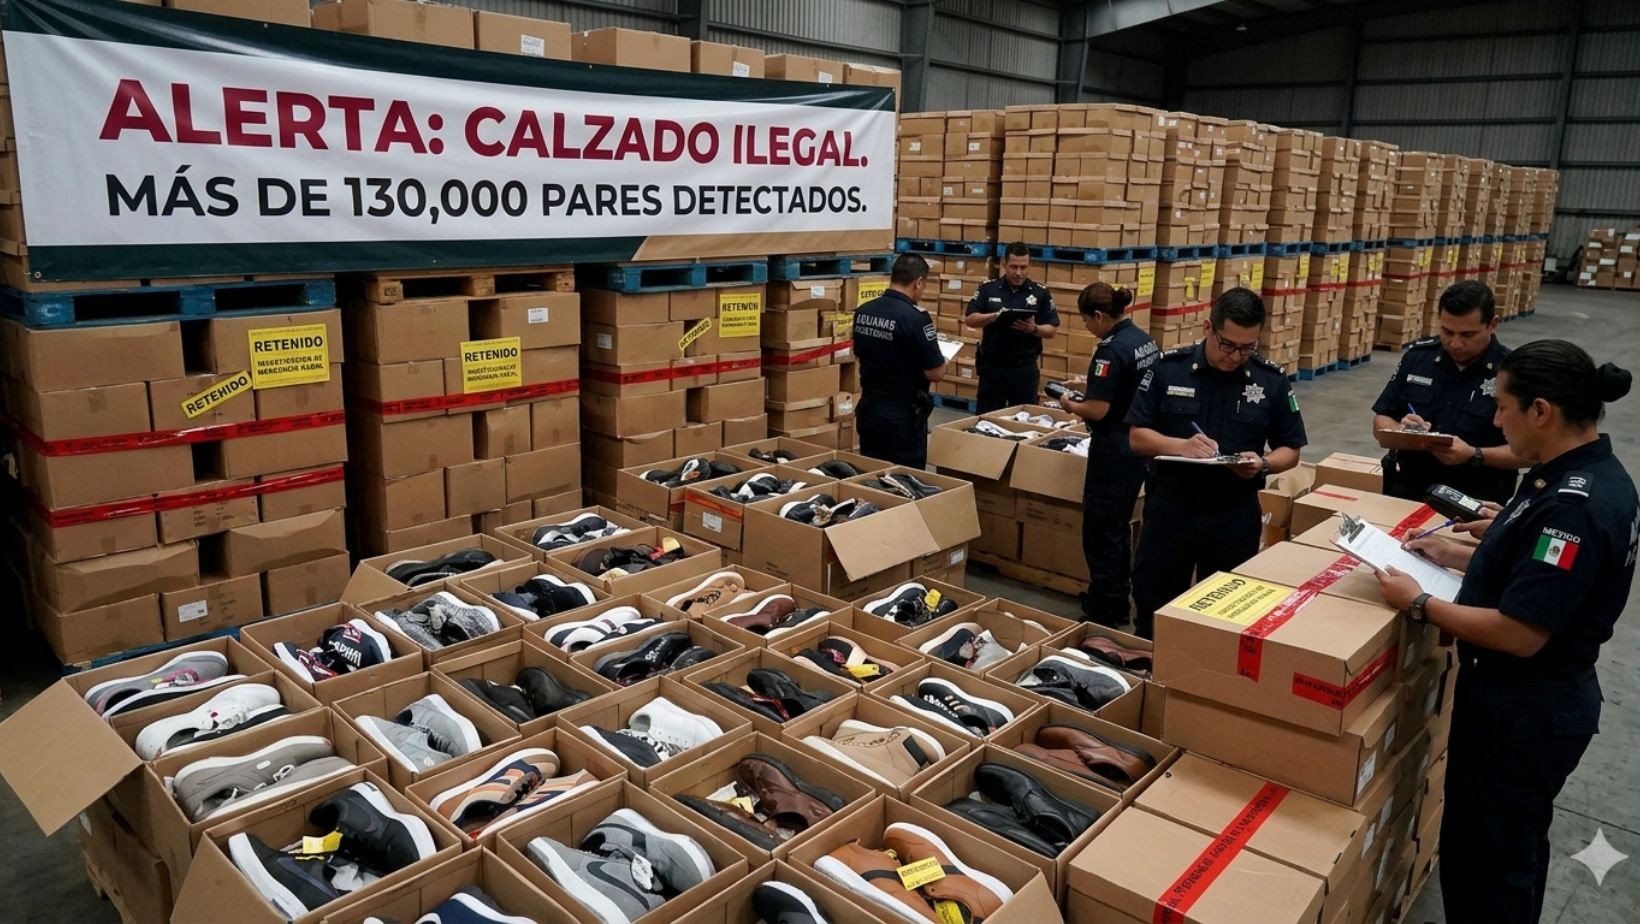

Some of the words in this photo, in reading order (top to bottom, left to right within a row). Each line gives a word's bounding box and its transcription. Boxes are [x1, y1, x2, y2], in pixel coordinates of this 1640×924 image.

[98, 78, 444, 155] ALERTA:
[465, 106, 720, 165] CALZADO
[733, 124, 868, 168] ILEGAL.
[105, 164, 239, 218] MÁS
[257, 177, 330, 217] DE
[343, 177, 528, 225] 130,000
[542, 183, 662, 217] PARES
[672, 185, 867, 217] DETECTADOS.
[254, 336, 323, 353] RETENIDO
[464, 347, 518, 363] RETENIDO
